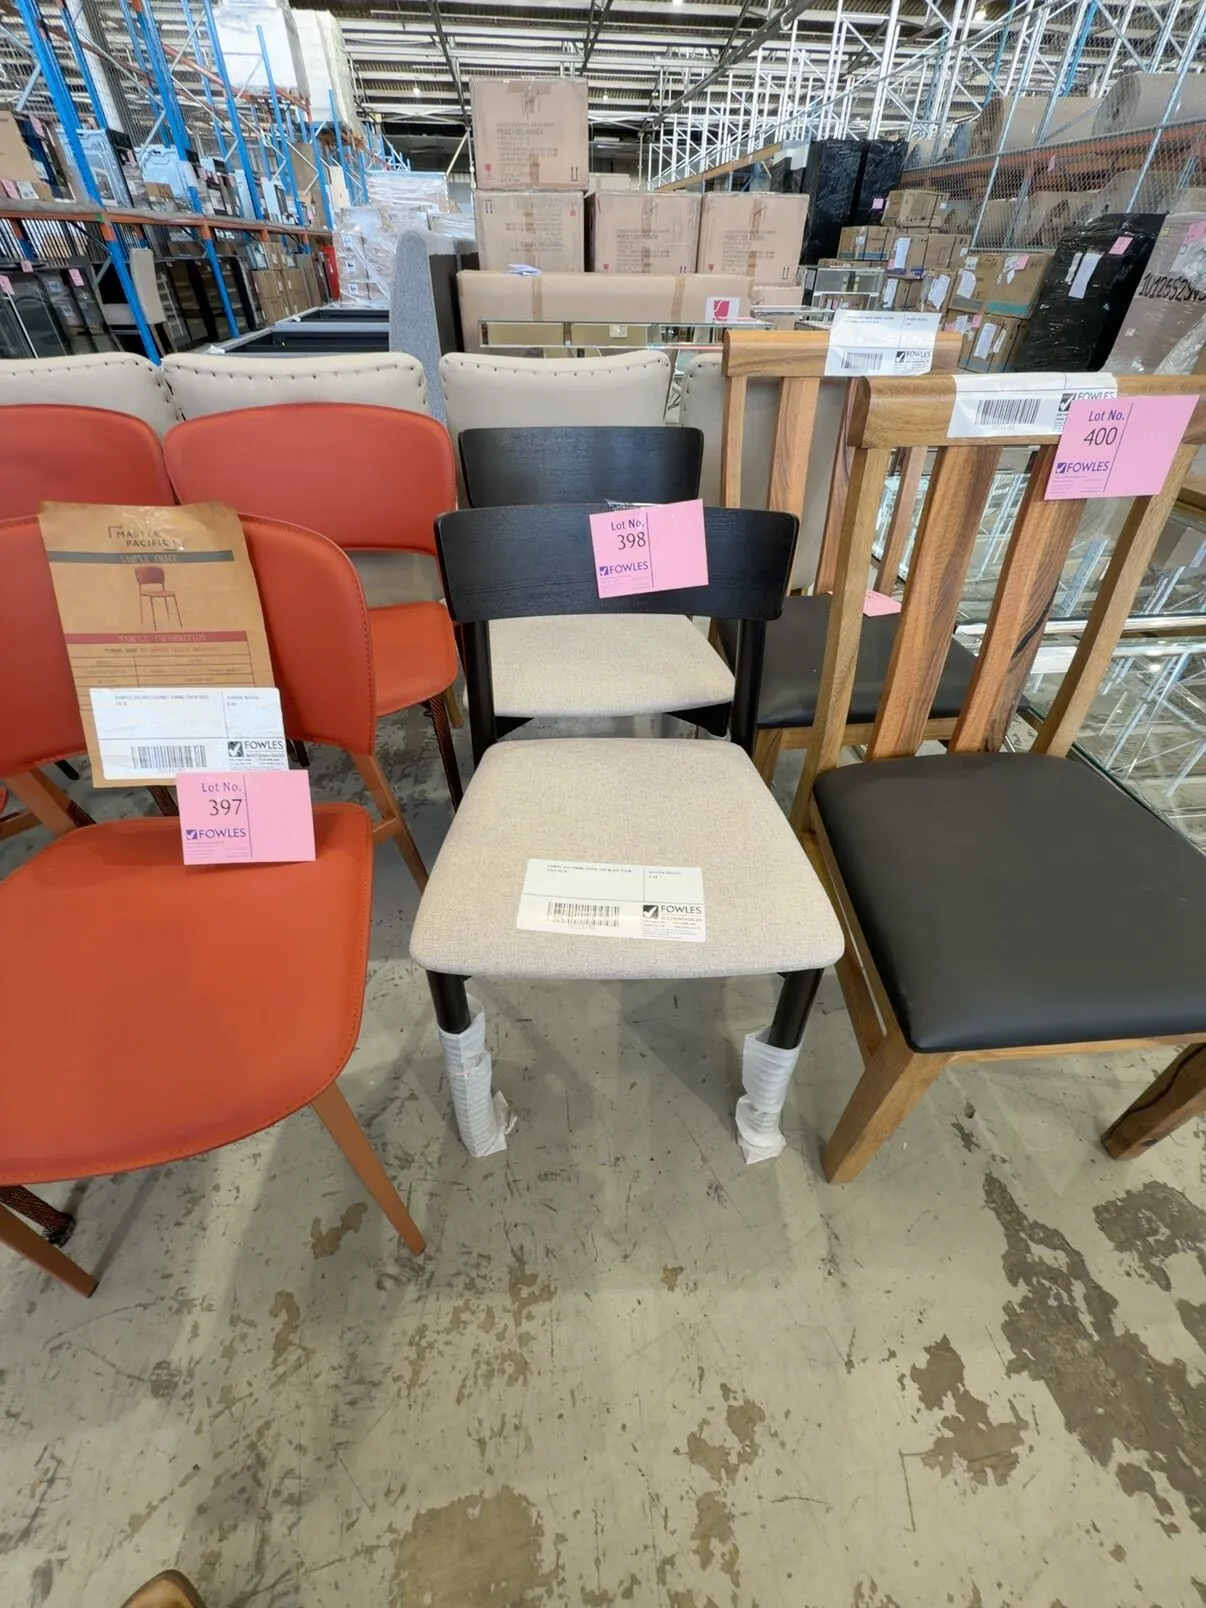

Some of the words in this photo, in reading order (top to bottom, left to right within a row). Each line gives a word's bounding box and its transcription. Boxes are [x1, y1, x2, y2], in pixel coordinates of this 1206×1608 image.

[906, 350, 932, 358] FOWLES
[1088, 411, 1105, 422] Lot
[1108, 409, 1125, 421] No.
[1083, 427, 1118, 446] 400
[1065, 461, 1109, 474] FOWLES
[611, 520, 626, 531] Lot
[628, 518, 645, 529] No.
[126, 539, 171, 548] PACIFIC
[617, 531, 646, 550] 398
[609, 560, 649, 575] FOWLES
[244, 740, 284, 750] FOWLES
[201, 782, 220, 793] Lot
[223, 782, 242, 792] No.
[208, 798, 243, 817] 397
[198, 828, 247, 840] FOWLES
[660, 904, 702, 915] FOWLES
